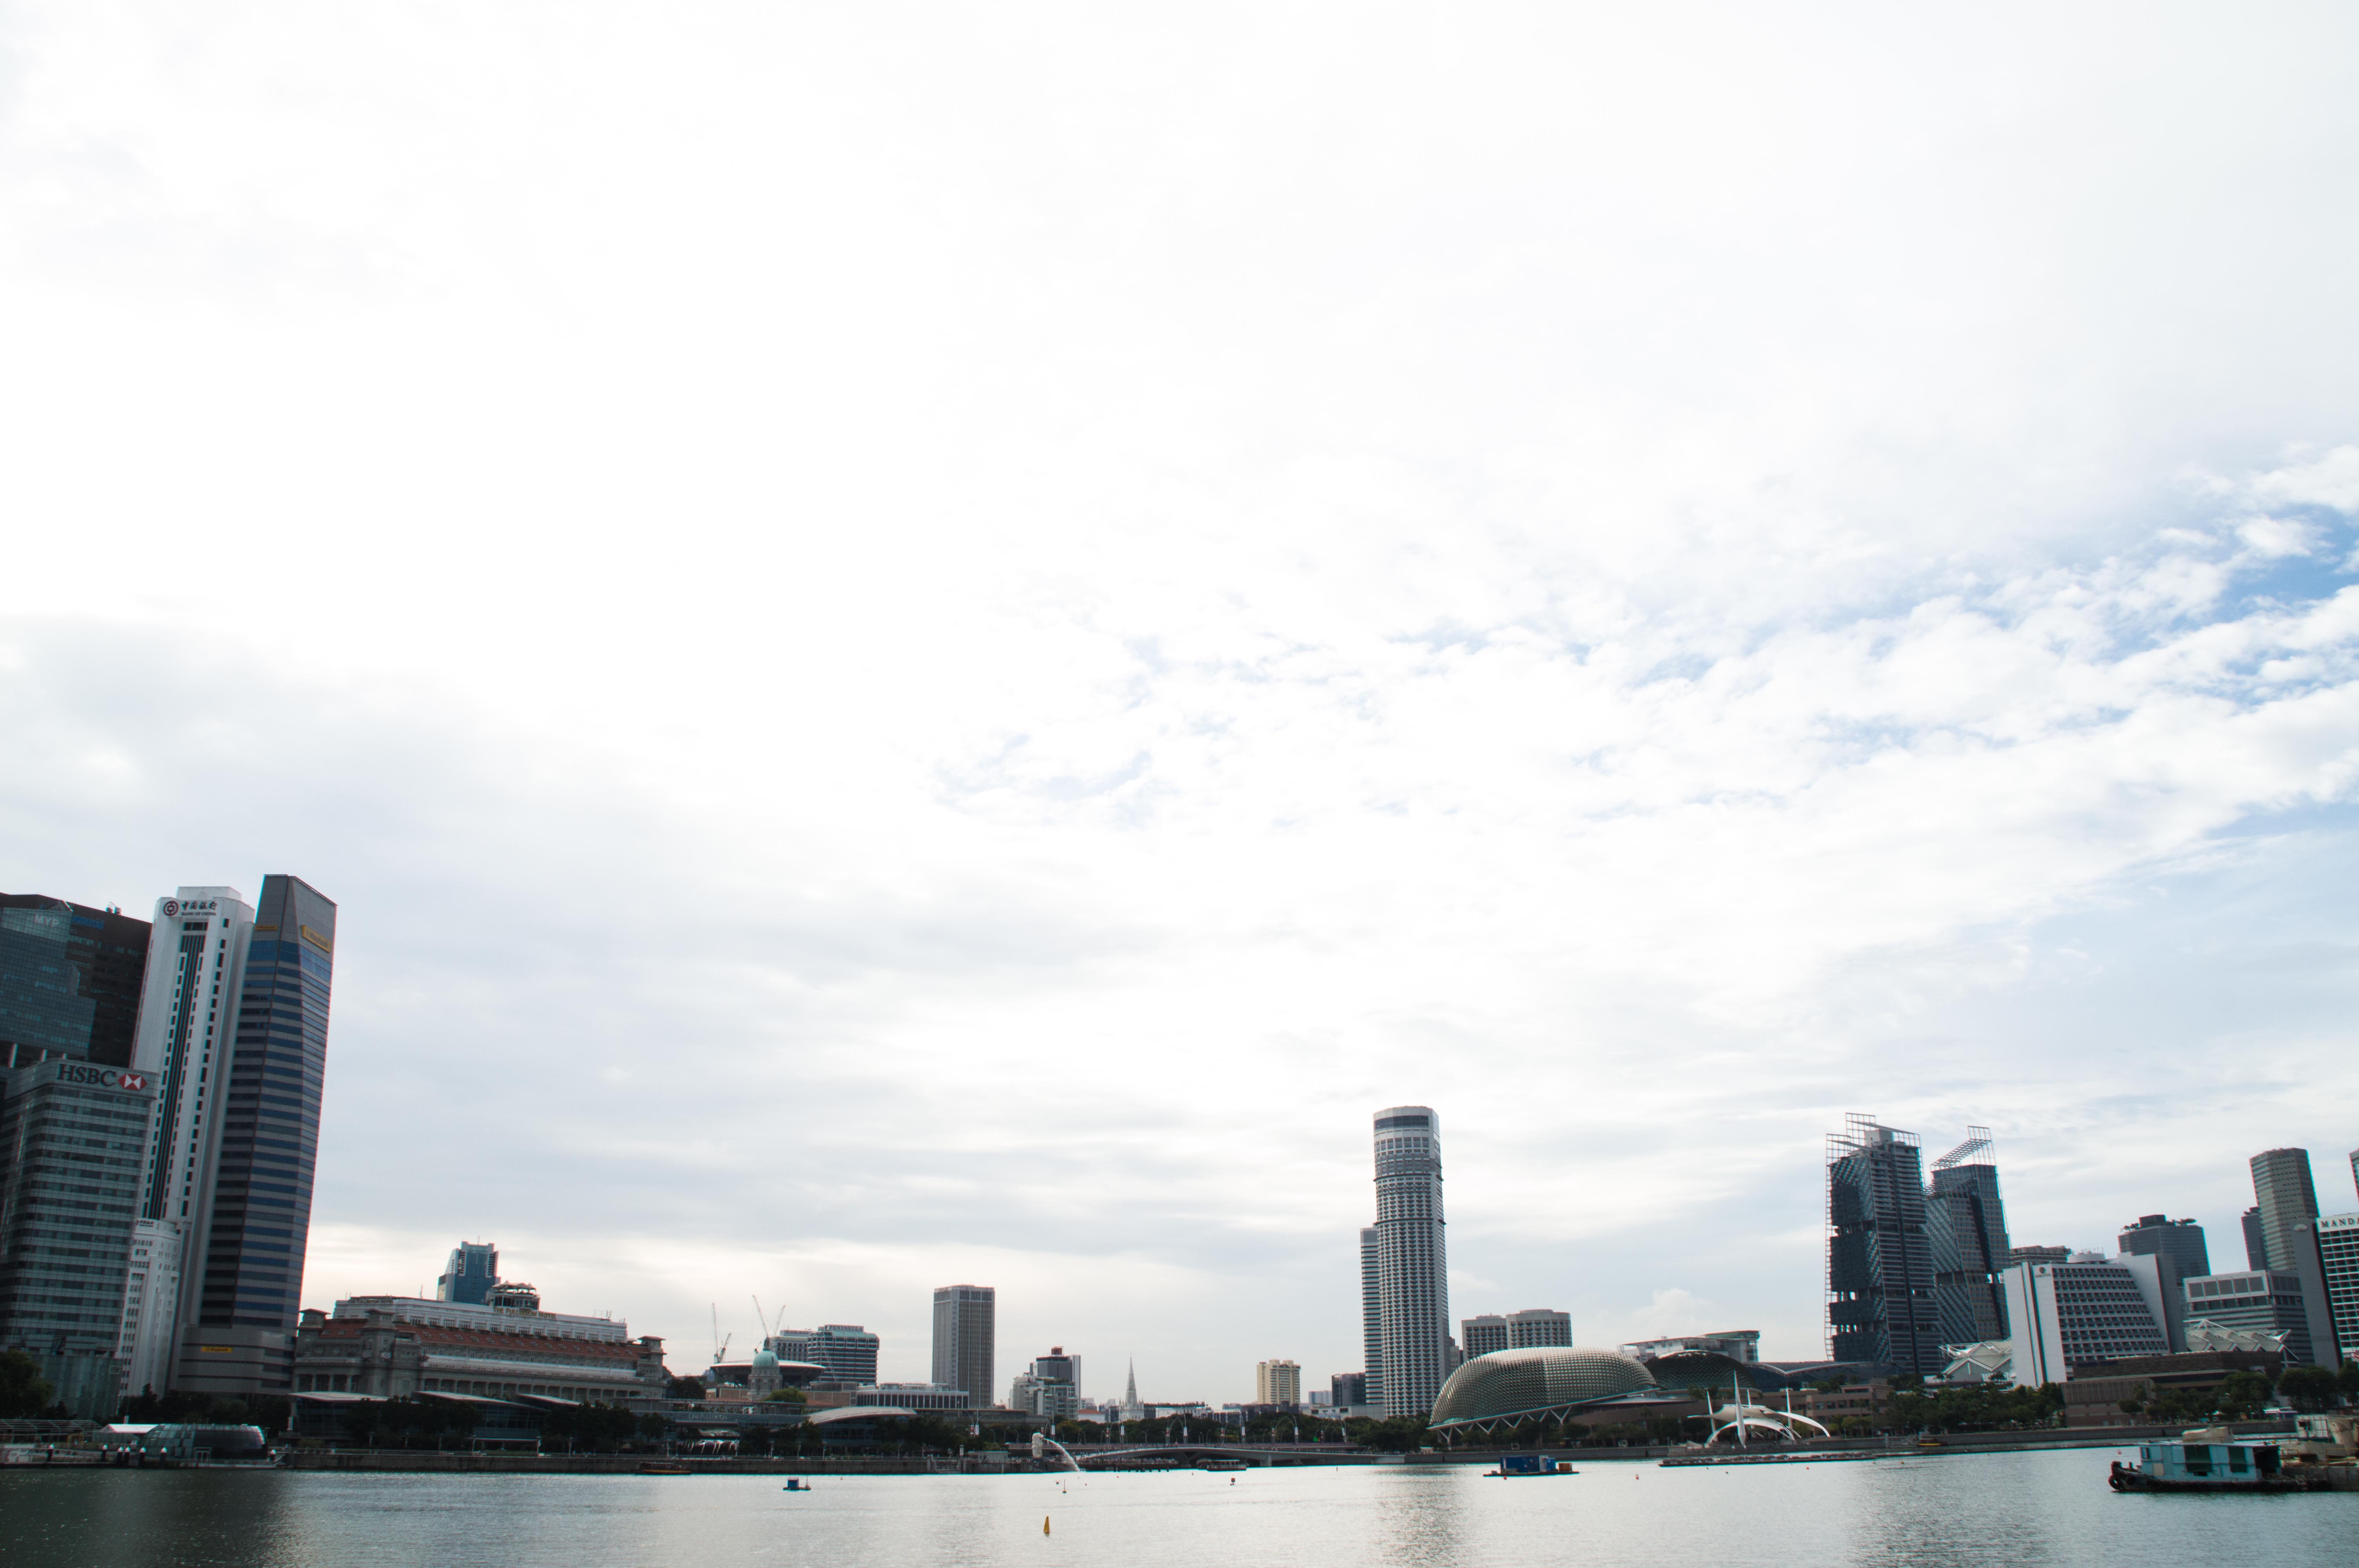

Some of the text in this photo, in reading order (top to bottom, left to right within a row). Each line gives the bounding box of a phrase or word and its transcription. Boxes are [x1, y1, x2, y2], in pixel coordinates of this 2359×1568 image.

[35, 913, 59, 927] MYP
[57, 1063, 116, 1086] HSBC
[2321, 1217, 2359, 1228] MAND
[506, 1307, 537, 1317] FULLERTON
[539, 1310, 556, 1319] HOTEL
